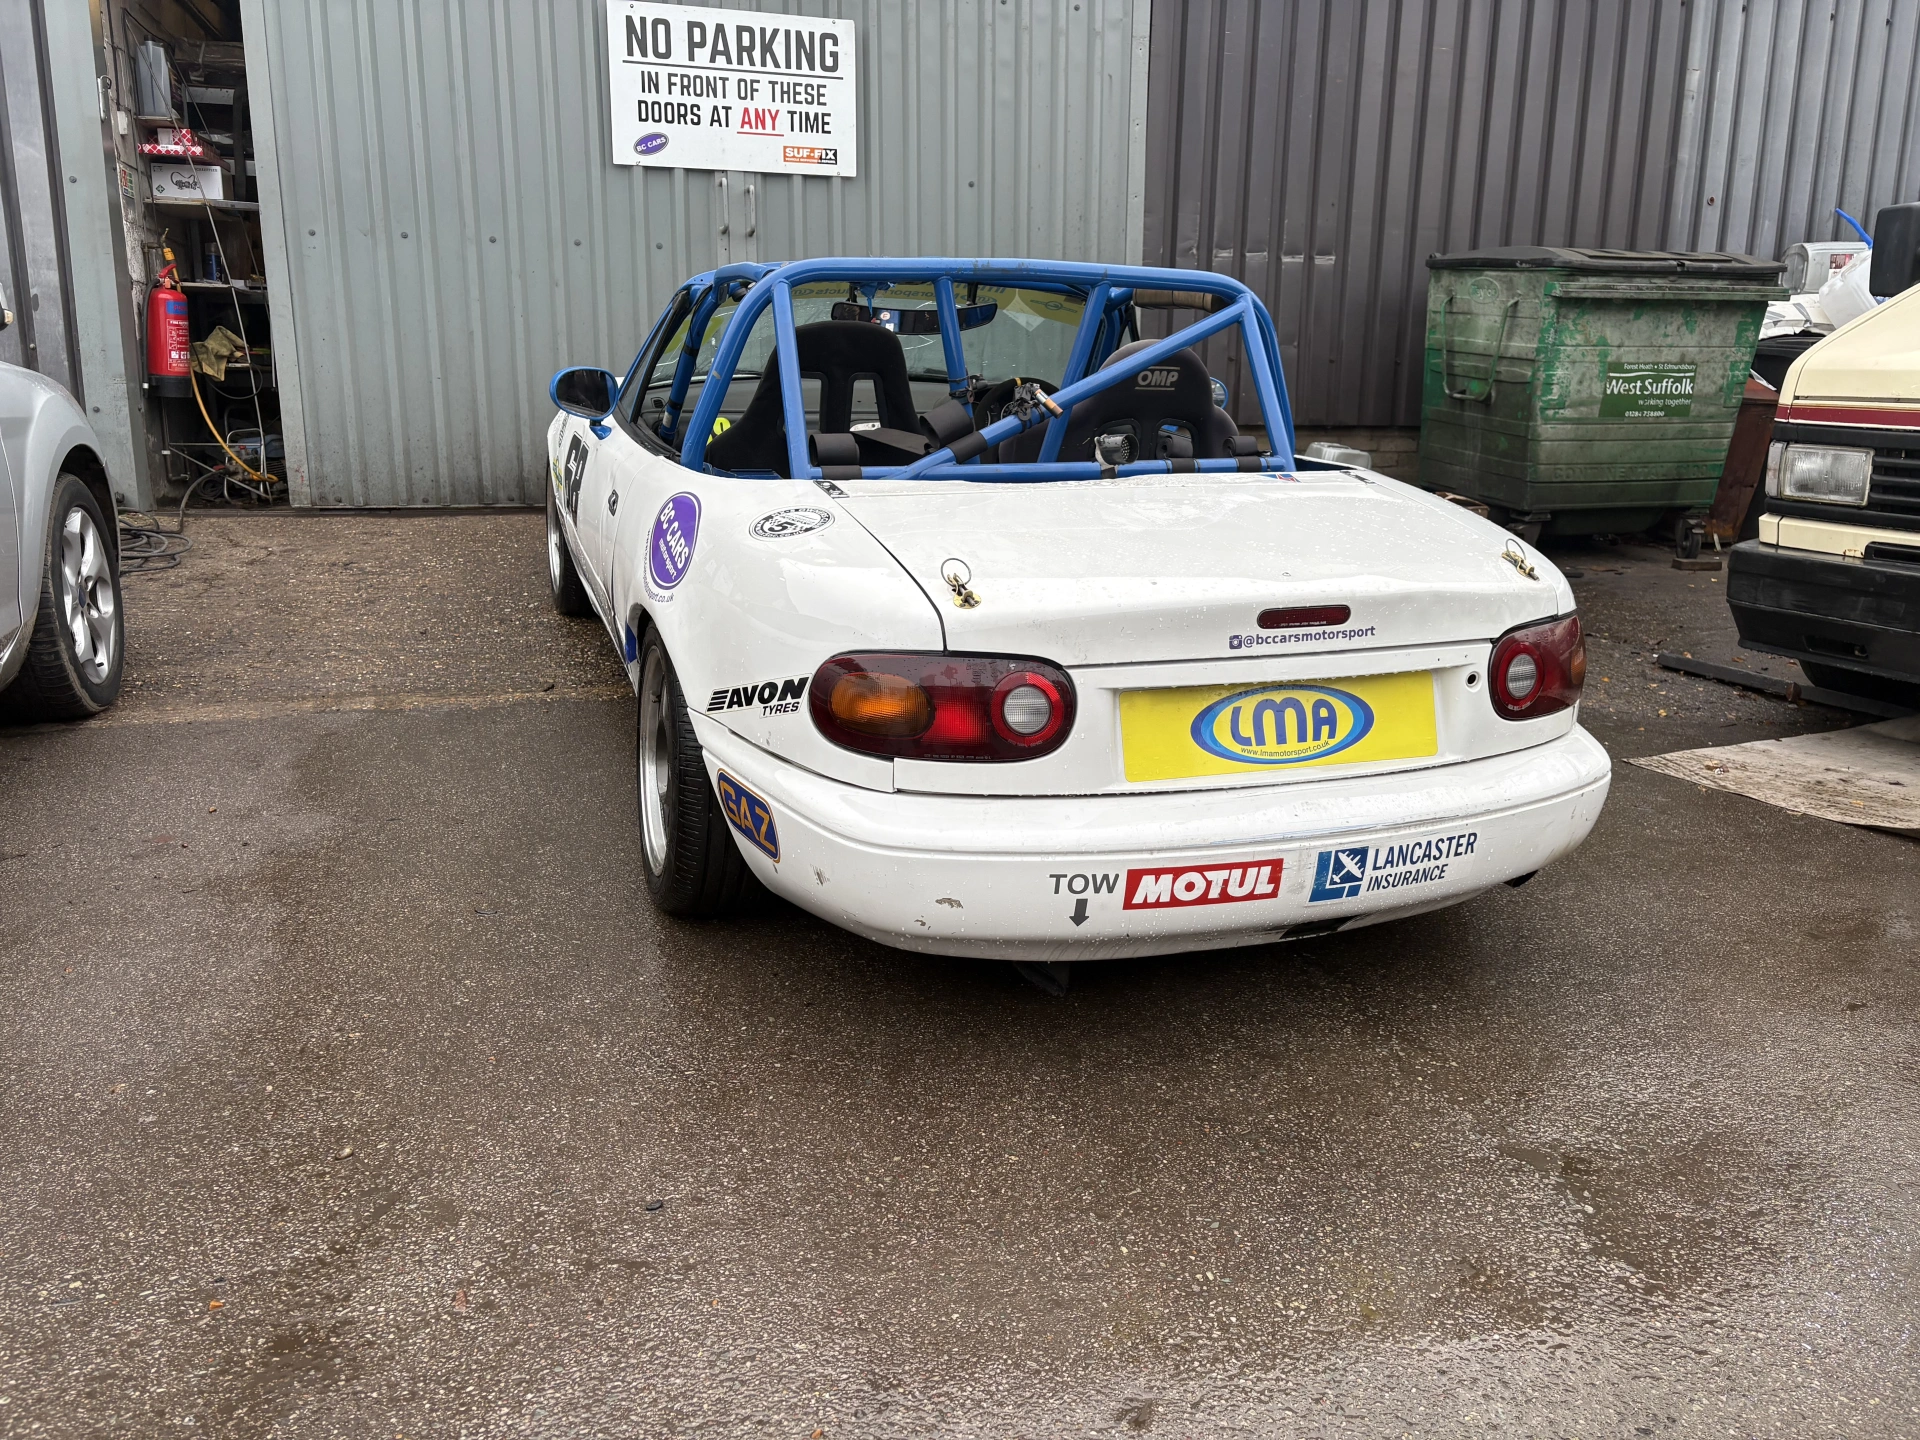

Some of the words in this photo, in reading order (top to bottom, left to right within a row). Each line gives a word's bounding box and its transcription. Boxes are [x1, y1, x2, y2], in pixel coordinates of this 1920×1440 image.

[625, 15, 672, 59] NO
[687, 20, 839, 73] PARKING
[641, 70, 660, 95] IN
[667, 73, 729, 99] FRONT
[737, 78, 760, 101] OF
[768, 81, 827, 106] THESE
[637, 100, 701, 126] DOORS
[709, 106, 732, 128] AT
[740, 107, 780, 131] ANY
[787, 110, 832, 134] TIME
[636, 144, 647, 152] BC
[647, 136, 666, 148] CARS
[1137, 370, 1179, 386] OMP
[1664, 363, 1696, 371] Edmundsbury
[1606, 378, 1642, 394] West
[1643, 377, 1694, 394] Suffolk
[1665, 397, 1692, 408] together
[660, 500, 676, 530] BC
[767, 521, 797, 533] 5
[659, 537, 677, 580] motorsport
[666, 521, 689, 569] CARS
[1243, 626, 1376, 648] @bccarsmotorsport
[726, 677, 809, 709] AVON
[762, 701, 800, 716] TYRES
[1230, 697, 1337, 746] LMA
[1240, 740, 1330, 758] www.lmamotorsport.co.uk
[720, 780, 776, 853] GAZ
[1372, 832, 1478, 871] LANCASTER
[1049, 873, 1119, 894] TOW
[1131, 866, 1275, 904] MOTUL
[1366, 863, 1448, 892] INSURANCE
